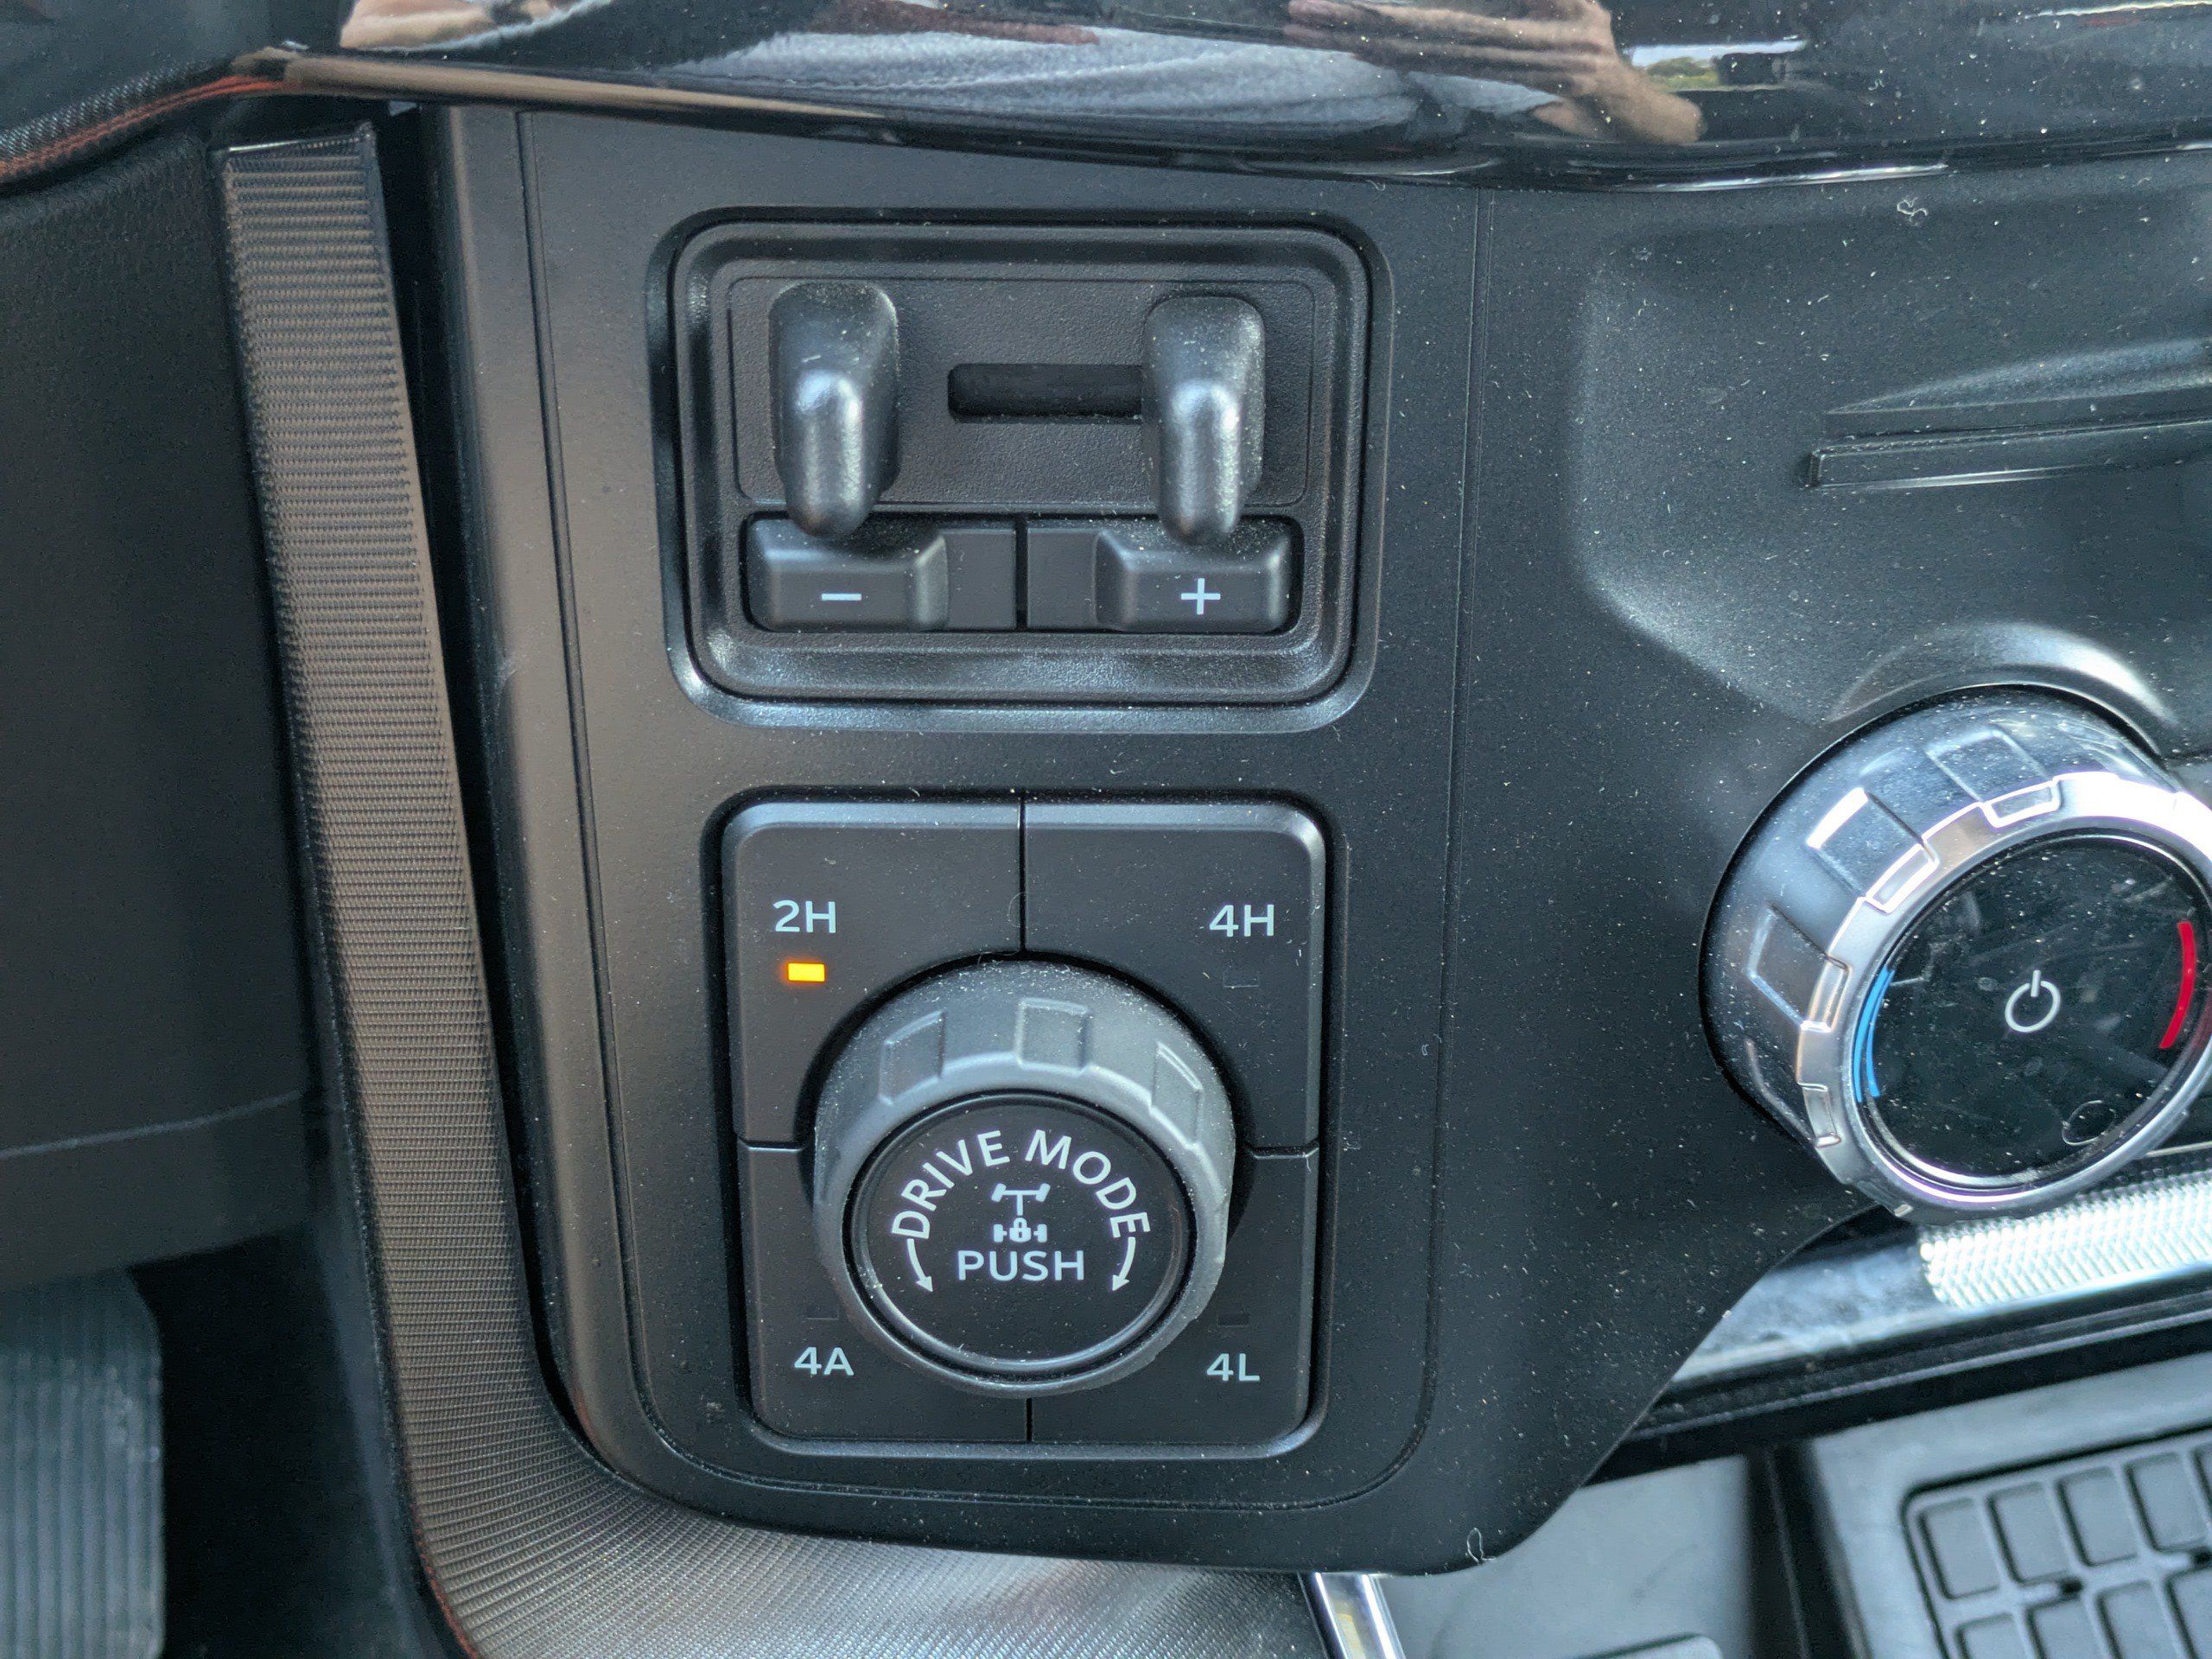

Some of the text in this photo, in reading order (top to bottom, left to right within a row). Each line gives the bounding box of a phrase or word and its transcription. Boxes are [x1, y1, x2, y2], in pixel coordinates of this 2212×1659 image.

[772, 899, 837, 934] 2H
[1208, 903, 1275, 938] 4H
[890, 1128, 1151, 1240] DRIVE MODE
[957, 1249, 1085, 1281] PUSH
[792, 1346, 855, 1376] 4A
[1205, 1352, 1262, 1382] 4L
